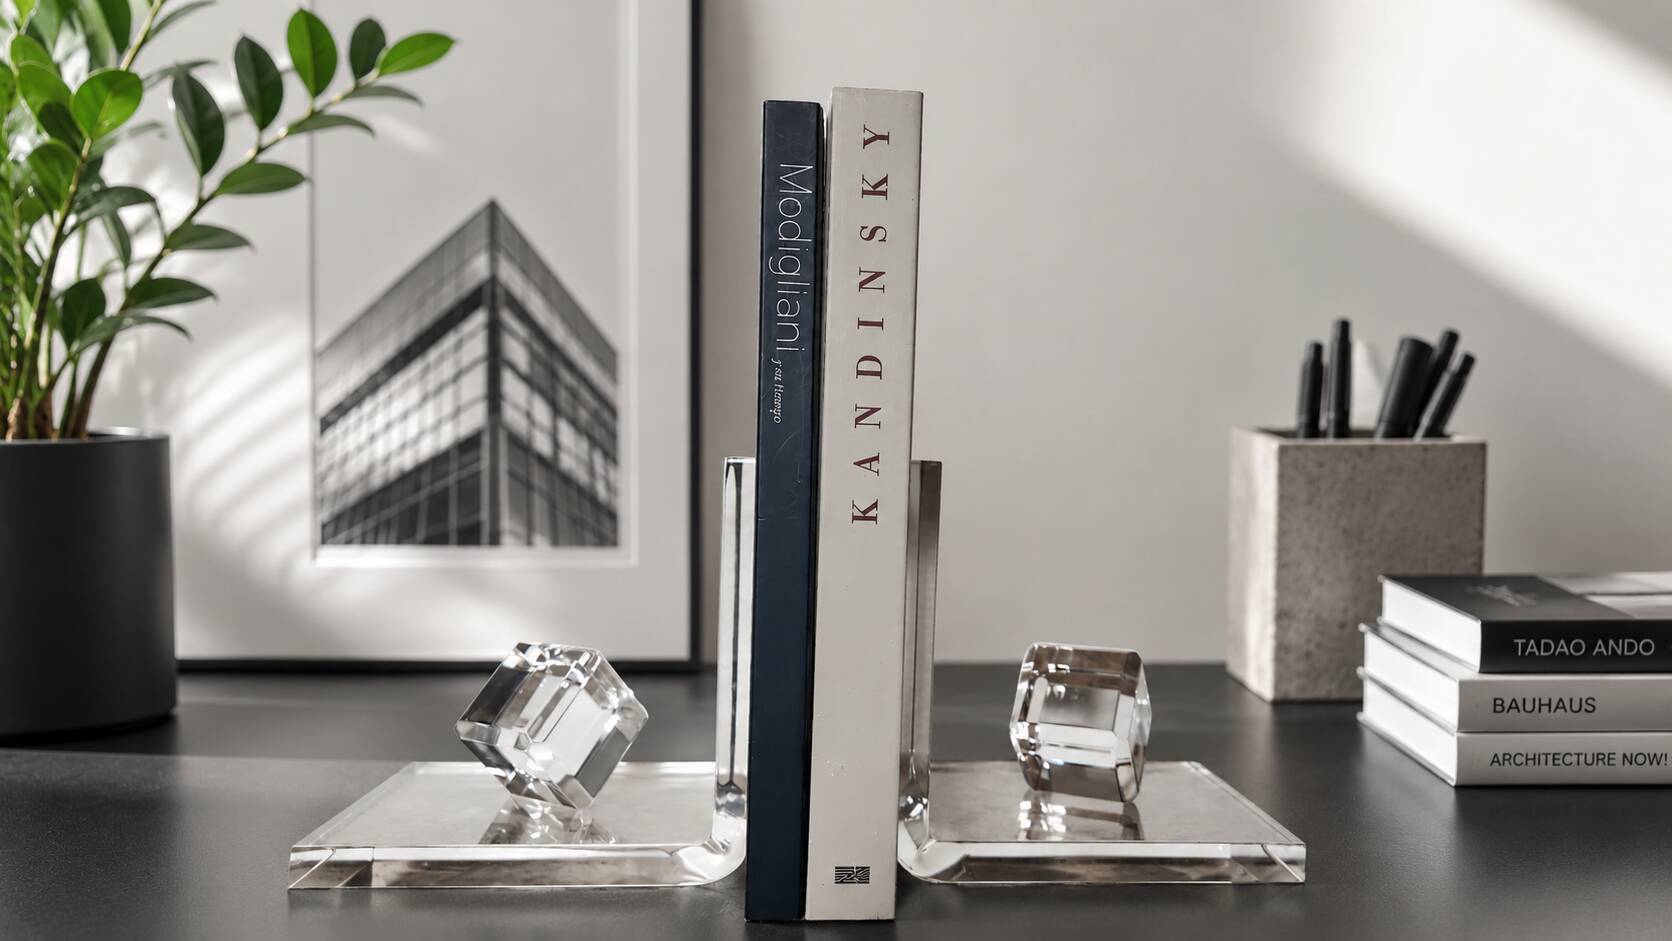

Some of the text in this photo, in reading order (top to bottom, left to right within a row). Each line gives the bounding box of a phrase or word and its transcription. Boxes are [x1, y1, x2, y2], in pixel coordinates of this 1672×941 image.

[768, 163, 813, 351] Modigliani
[852, 124, 890, 524] KANDINSKY
[1514, 639, 1655, 656] TADAO ANDO
[1492, 697, 1596, 713] BAUHAUS
[1490, 753, 1668, 767] ARCHITECTURE NOW!
